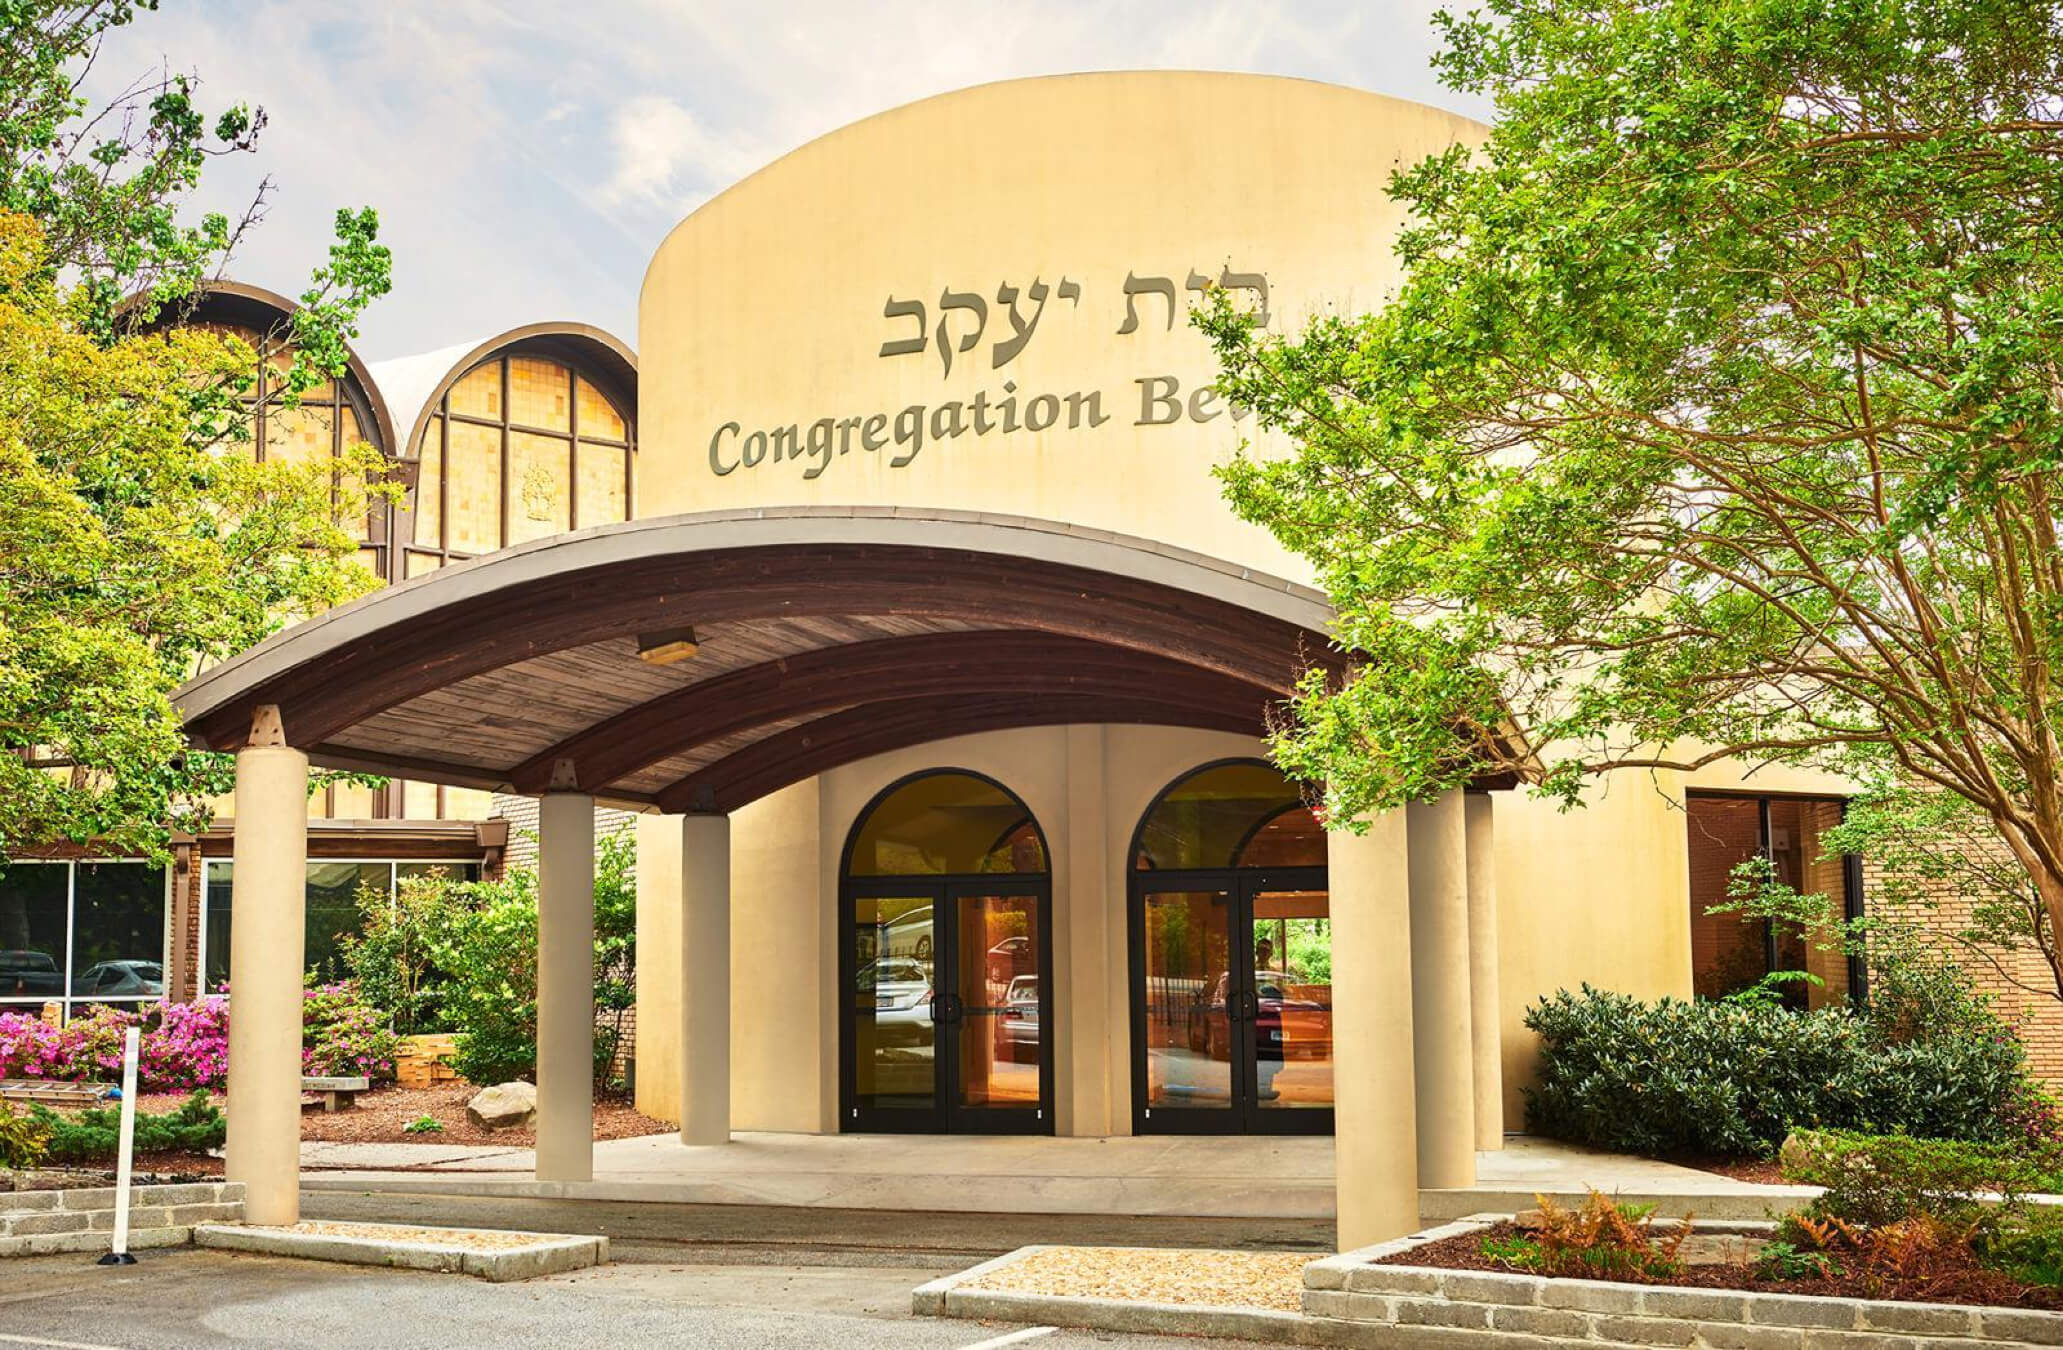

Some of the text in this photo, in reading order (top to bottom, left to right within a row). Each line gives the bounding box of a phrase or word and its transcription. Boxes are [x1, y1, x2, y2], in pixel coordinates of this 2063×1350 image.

[879, 266, 1272, 381] בית יעקב
[709, 376, 1265, 480] Congregation Be
